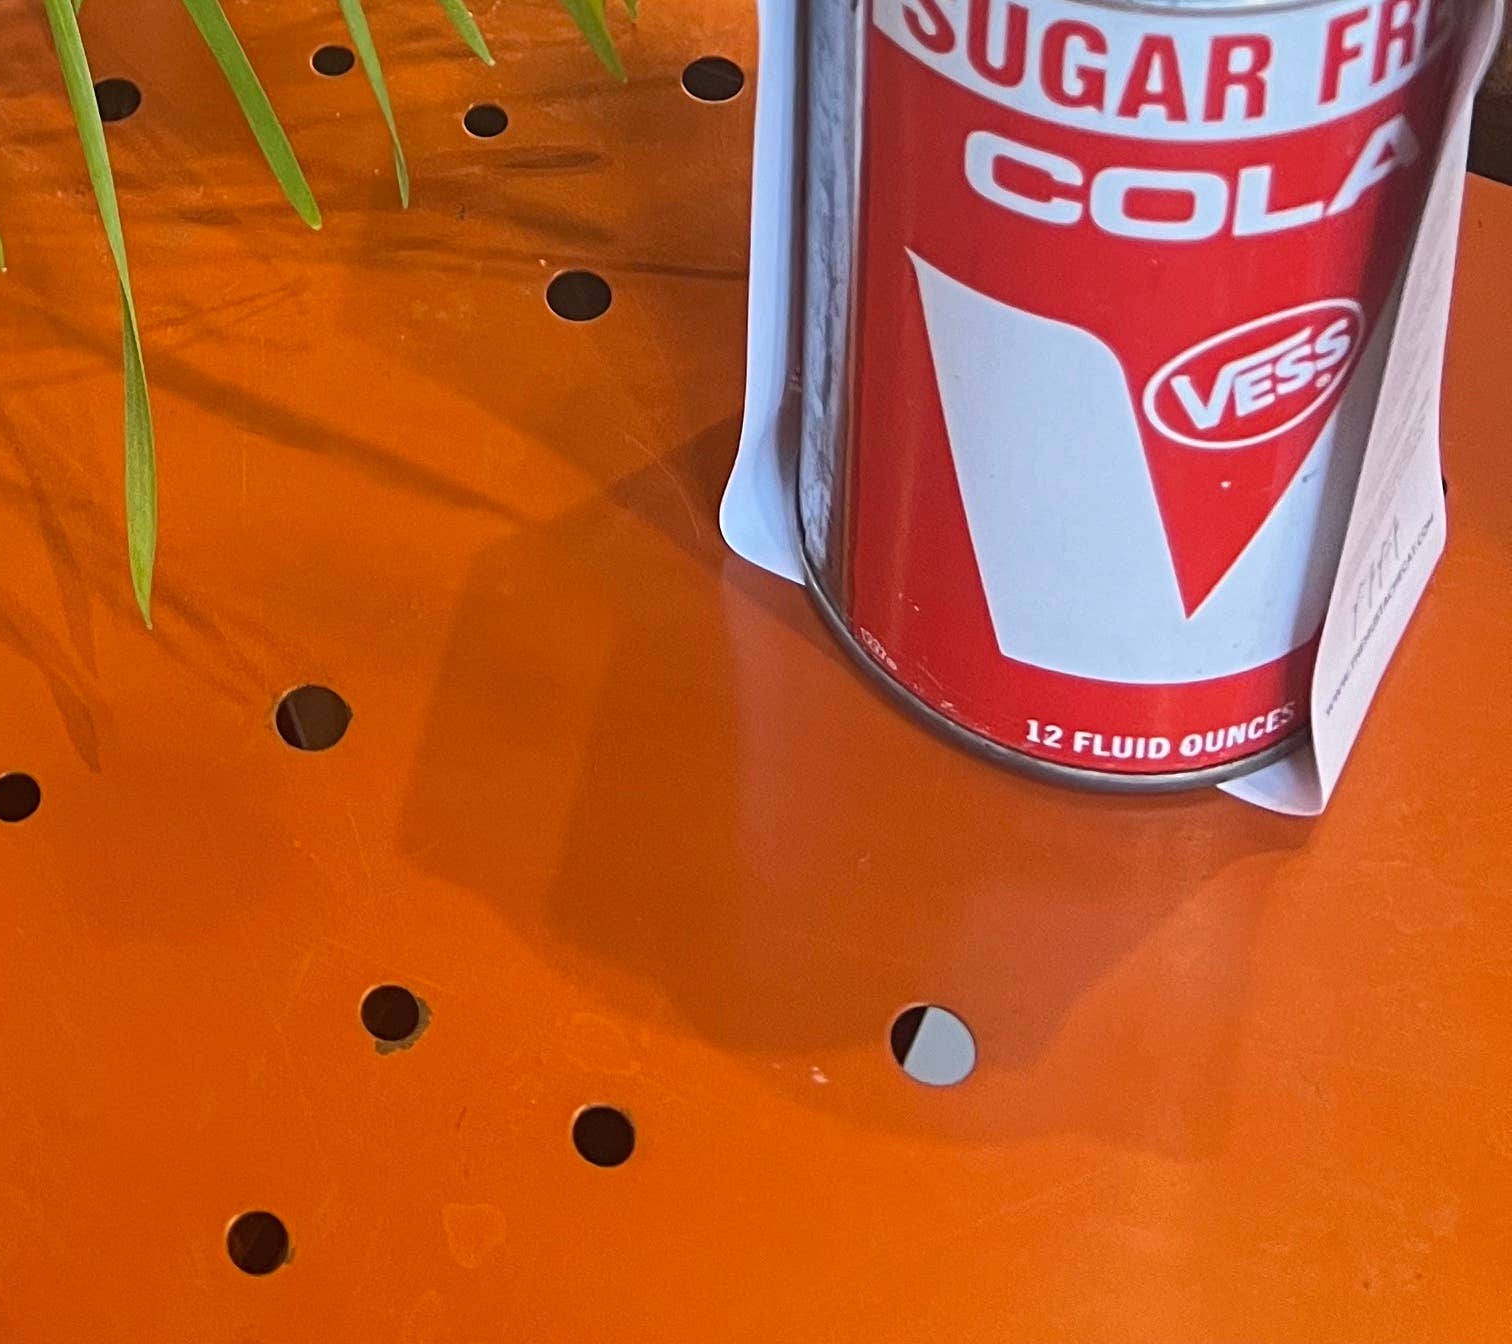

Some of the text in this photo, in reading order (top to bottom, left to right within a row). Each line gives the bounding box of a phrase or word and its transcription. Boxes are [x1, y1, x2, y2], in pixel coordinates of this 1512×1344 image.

[963, 113, 1420, 242] COLA
[1170, 318, 1351, 430] VESS
[1025, 702, 1295, 759] 12 FLUID OUNCES
